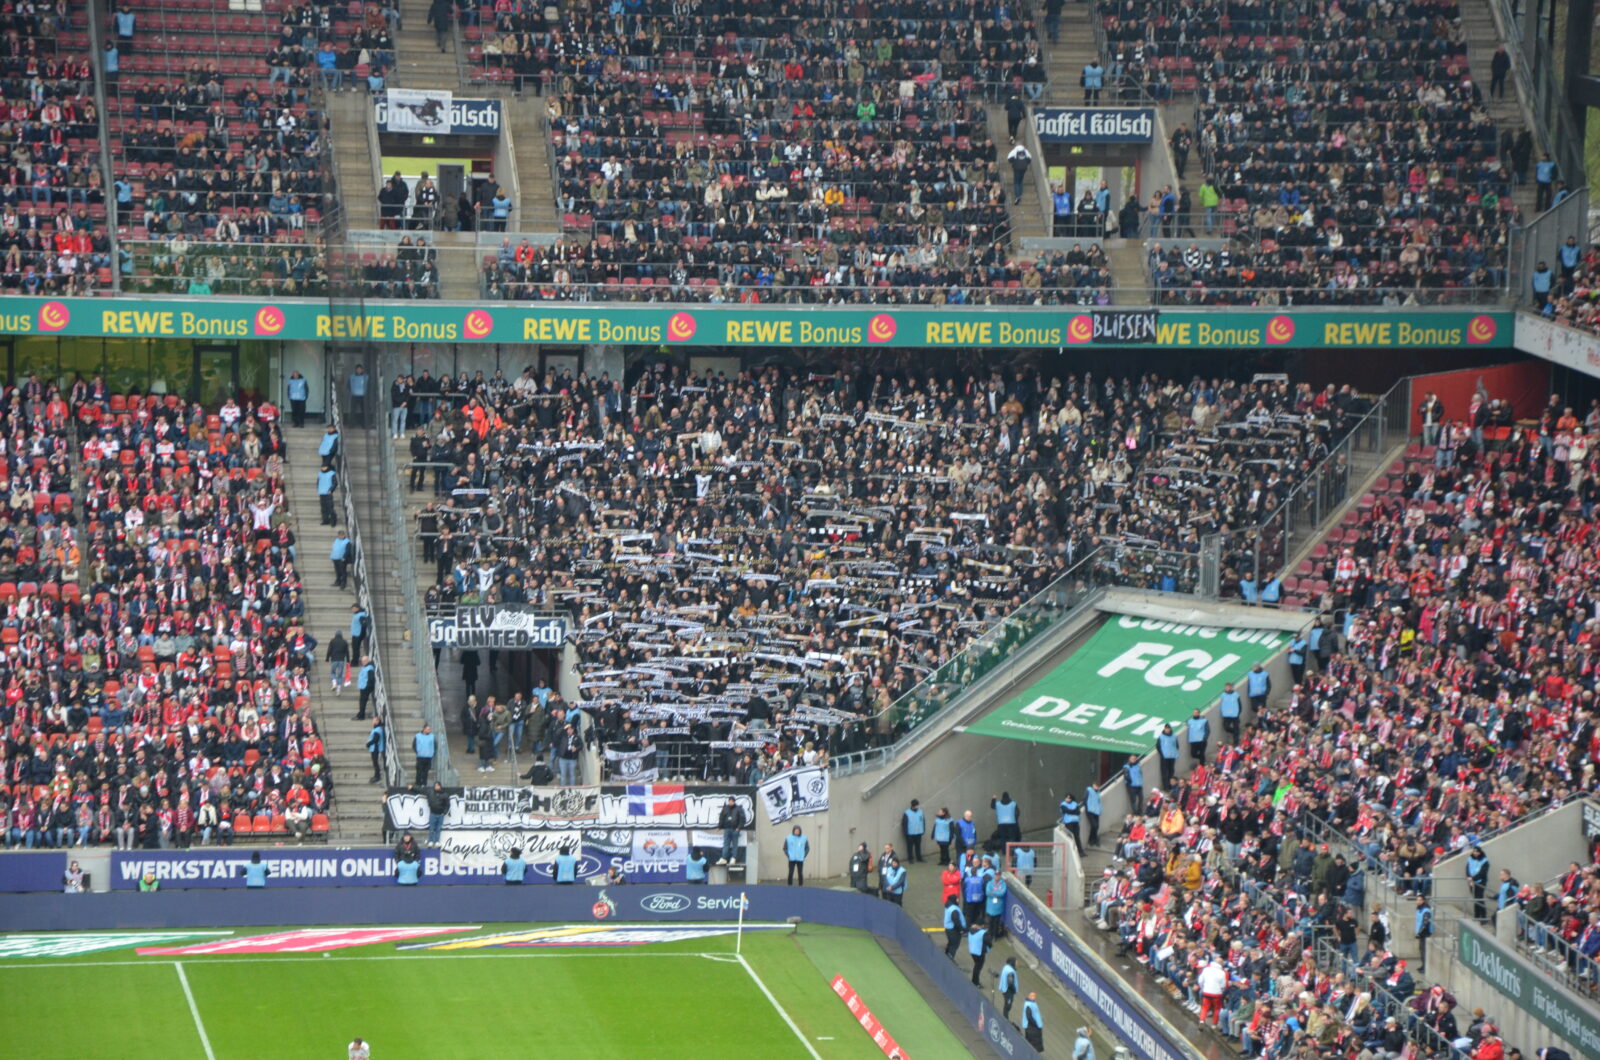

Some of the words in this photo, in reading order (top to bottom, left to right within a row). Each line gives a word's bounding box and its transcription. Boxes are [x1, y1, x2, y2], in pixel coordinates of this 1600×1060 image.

[450, 104, 499, 130] ölsch
[1090, 112, 1152, 138] Kölsch
[102, 310, 175, 334] REWE
[181, 312, 248, 336] Bonus
[316, 314, 386, 338] REWE
[392, 315, 457, 340] Bonus
[523, 318, 592, 341] REWE
[598, 319, 661, 342] Bonus
[726, 320, 793, 344] REWE
[799, 321, 862, 344] Bonus
[926, 321, 993, 344] REWE
[999, 322, 1061, 345] Bonus
[1155, 323, 1192, 345] WE
[1198, 323, 1260, 345] Bonus
[1324, 322, 1392, 345] REWE
[1398, 323, 1461, 346] Bonus
[457, 605, 496, 628] ELV
[457, 629, 529, 647] UNITED
[532, 621, 562, 647] sch
[1097, 642, 1241, 691] FC!
[1019, 695, 1183, 739] DEVK
[465, 801, 516, 813] KOLLEKTIV
[441, 836, 489, 861] Loyal
[526, 833, 580, 854] Unity
[120, 858, 337, 880] WERKSTATERMIN
[340, 857, 399, 877] ONLI
[424, 856, 503, 876] BUCHE
[610, 857, 680, 873] Service
[649, 895, 681, 910] Ford
[1026, 920, 1043, 950] Service
[1472, 939, 1521, 998] DocMorris
[1533, 986, 1545, 1012] Für
[1545, 995, 1564, 1024] jedes
[1563, 1009, 1581, 1037] Spiel
[1098, 988, 1114, 1019] JETZT
[1113, 1003, 1134, 1039] ONLINE
[1132, 1021, 1156, 1060] BUCHEN
